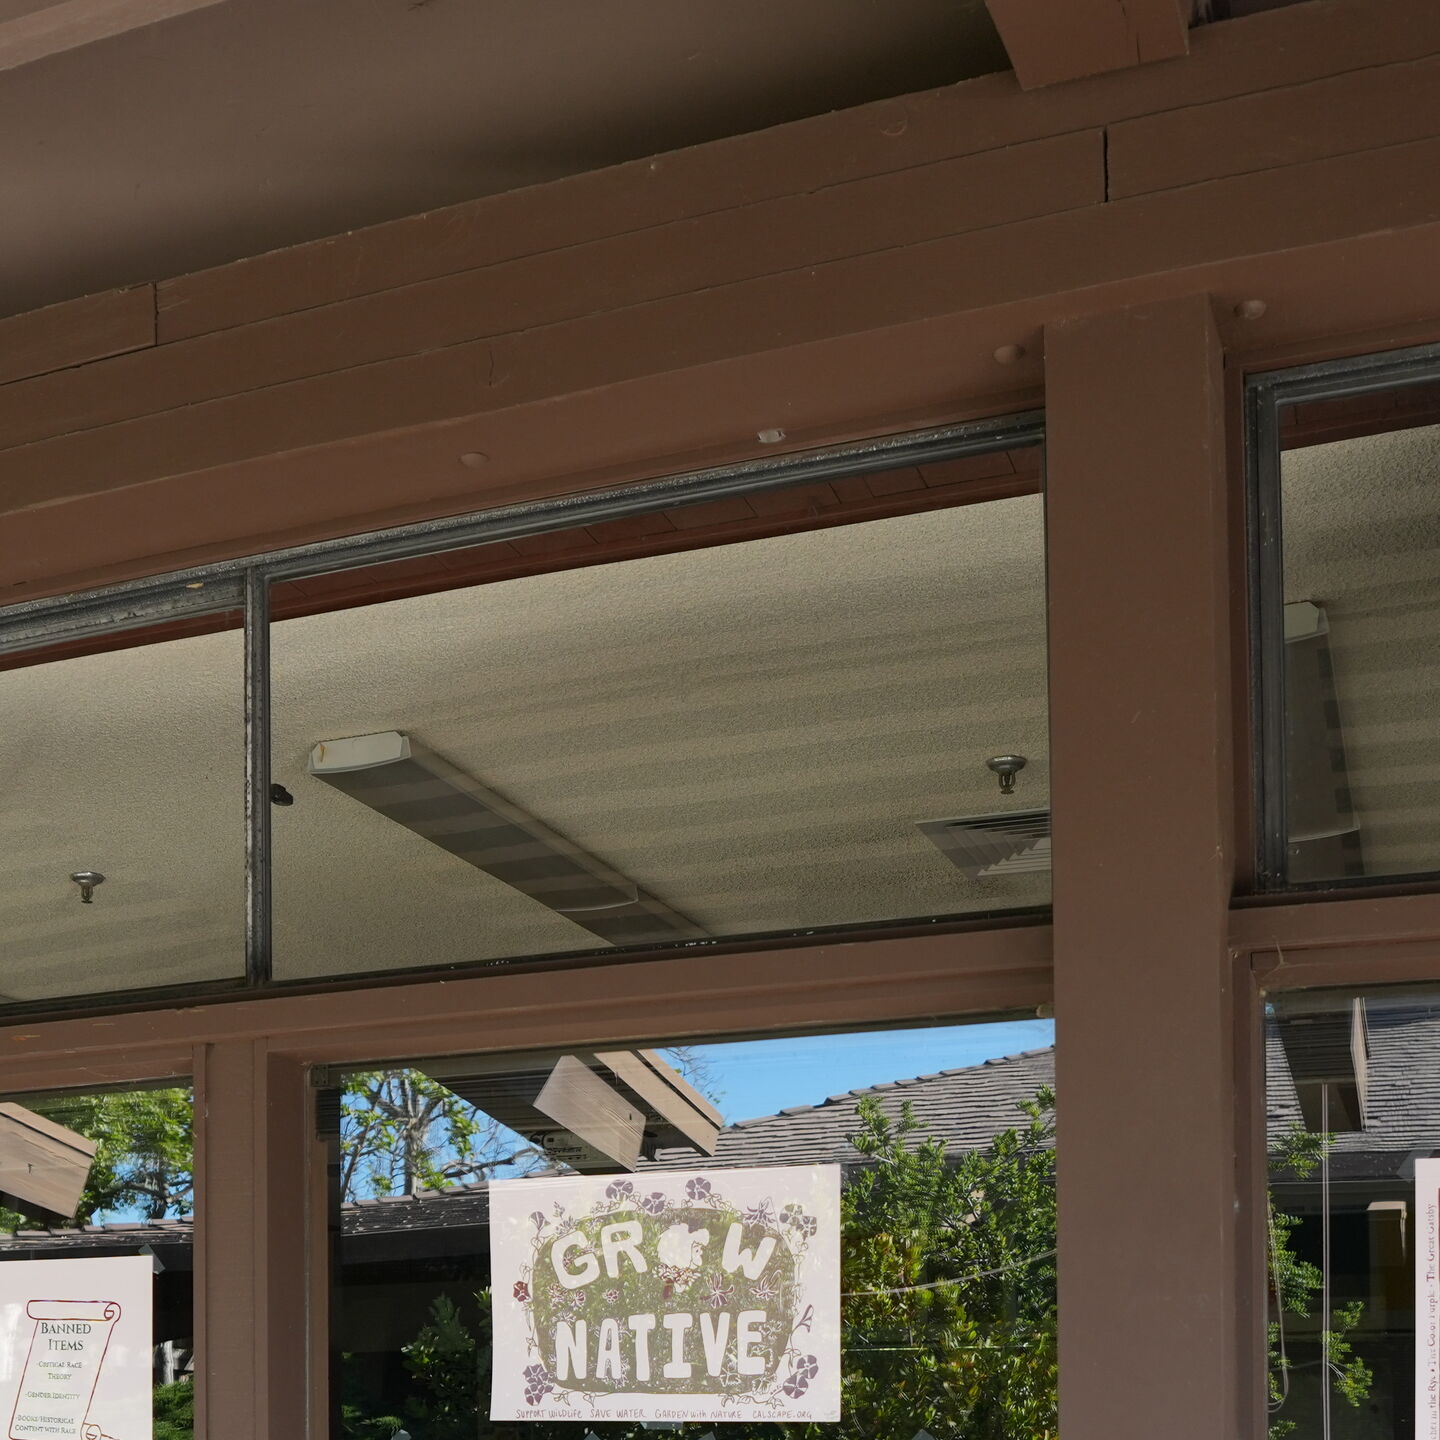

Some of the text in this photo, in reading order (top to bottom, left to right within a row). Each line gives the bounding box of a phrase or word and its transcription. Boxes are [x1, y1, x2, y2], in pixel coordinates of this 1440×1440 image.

[1426, 1263, 1435, 1282] The
[41, 1322, 92, 1335] BANNED
[48, 1339, 84, 1351] ITEMS
[555, 1310, 767, 1382] NATIVE
[67, 1361, 82, 1369] RACE
[1428, 1394, 1437, 1409] the
[515, 1408, 546, 1419] SUPPORT
[589, 1408, 612, 1418] SAVE
[616, 1408, 647, 1418] WATER
[654, 1409, 688, 1419] GARDEN
[690, 1409, 707, 1418] with
[711, 1409, 743, 1419] NATURE
